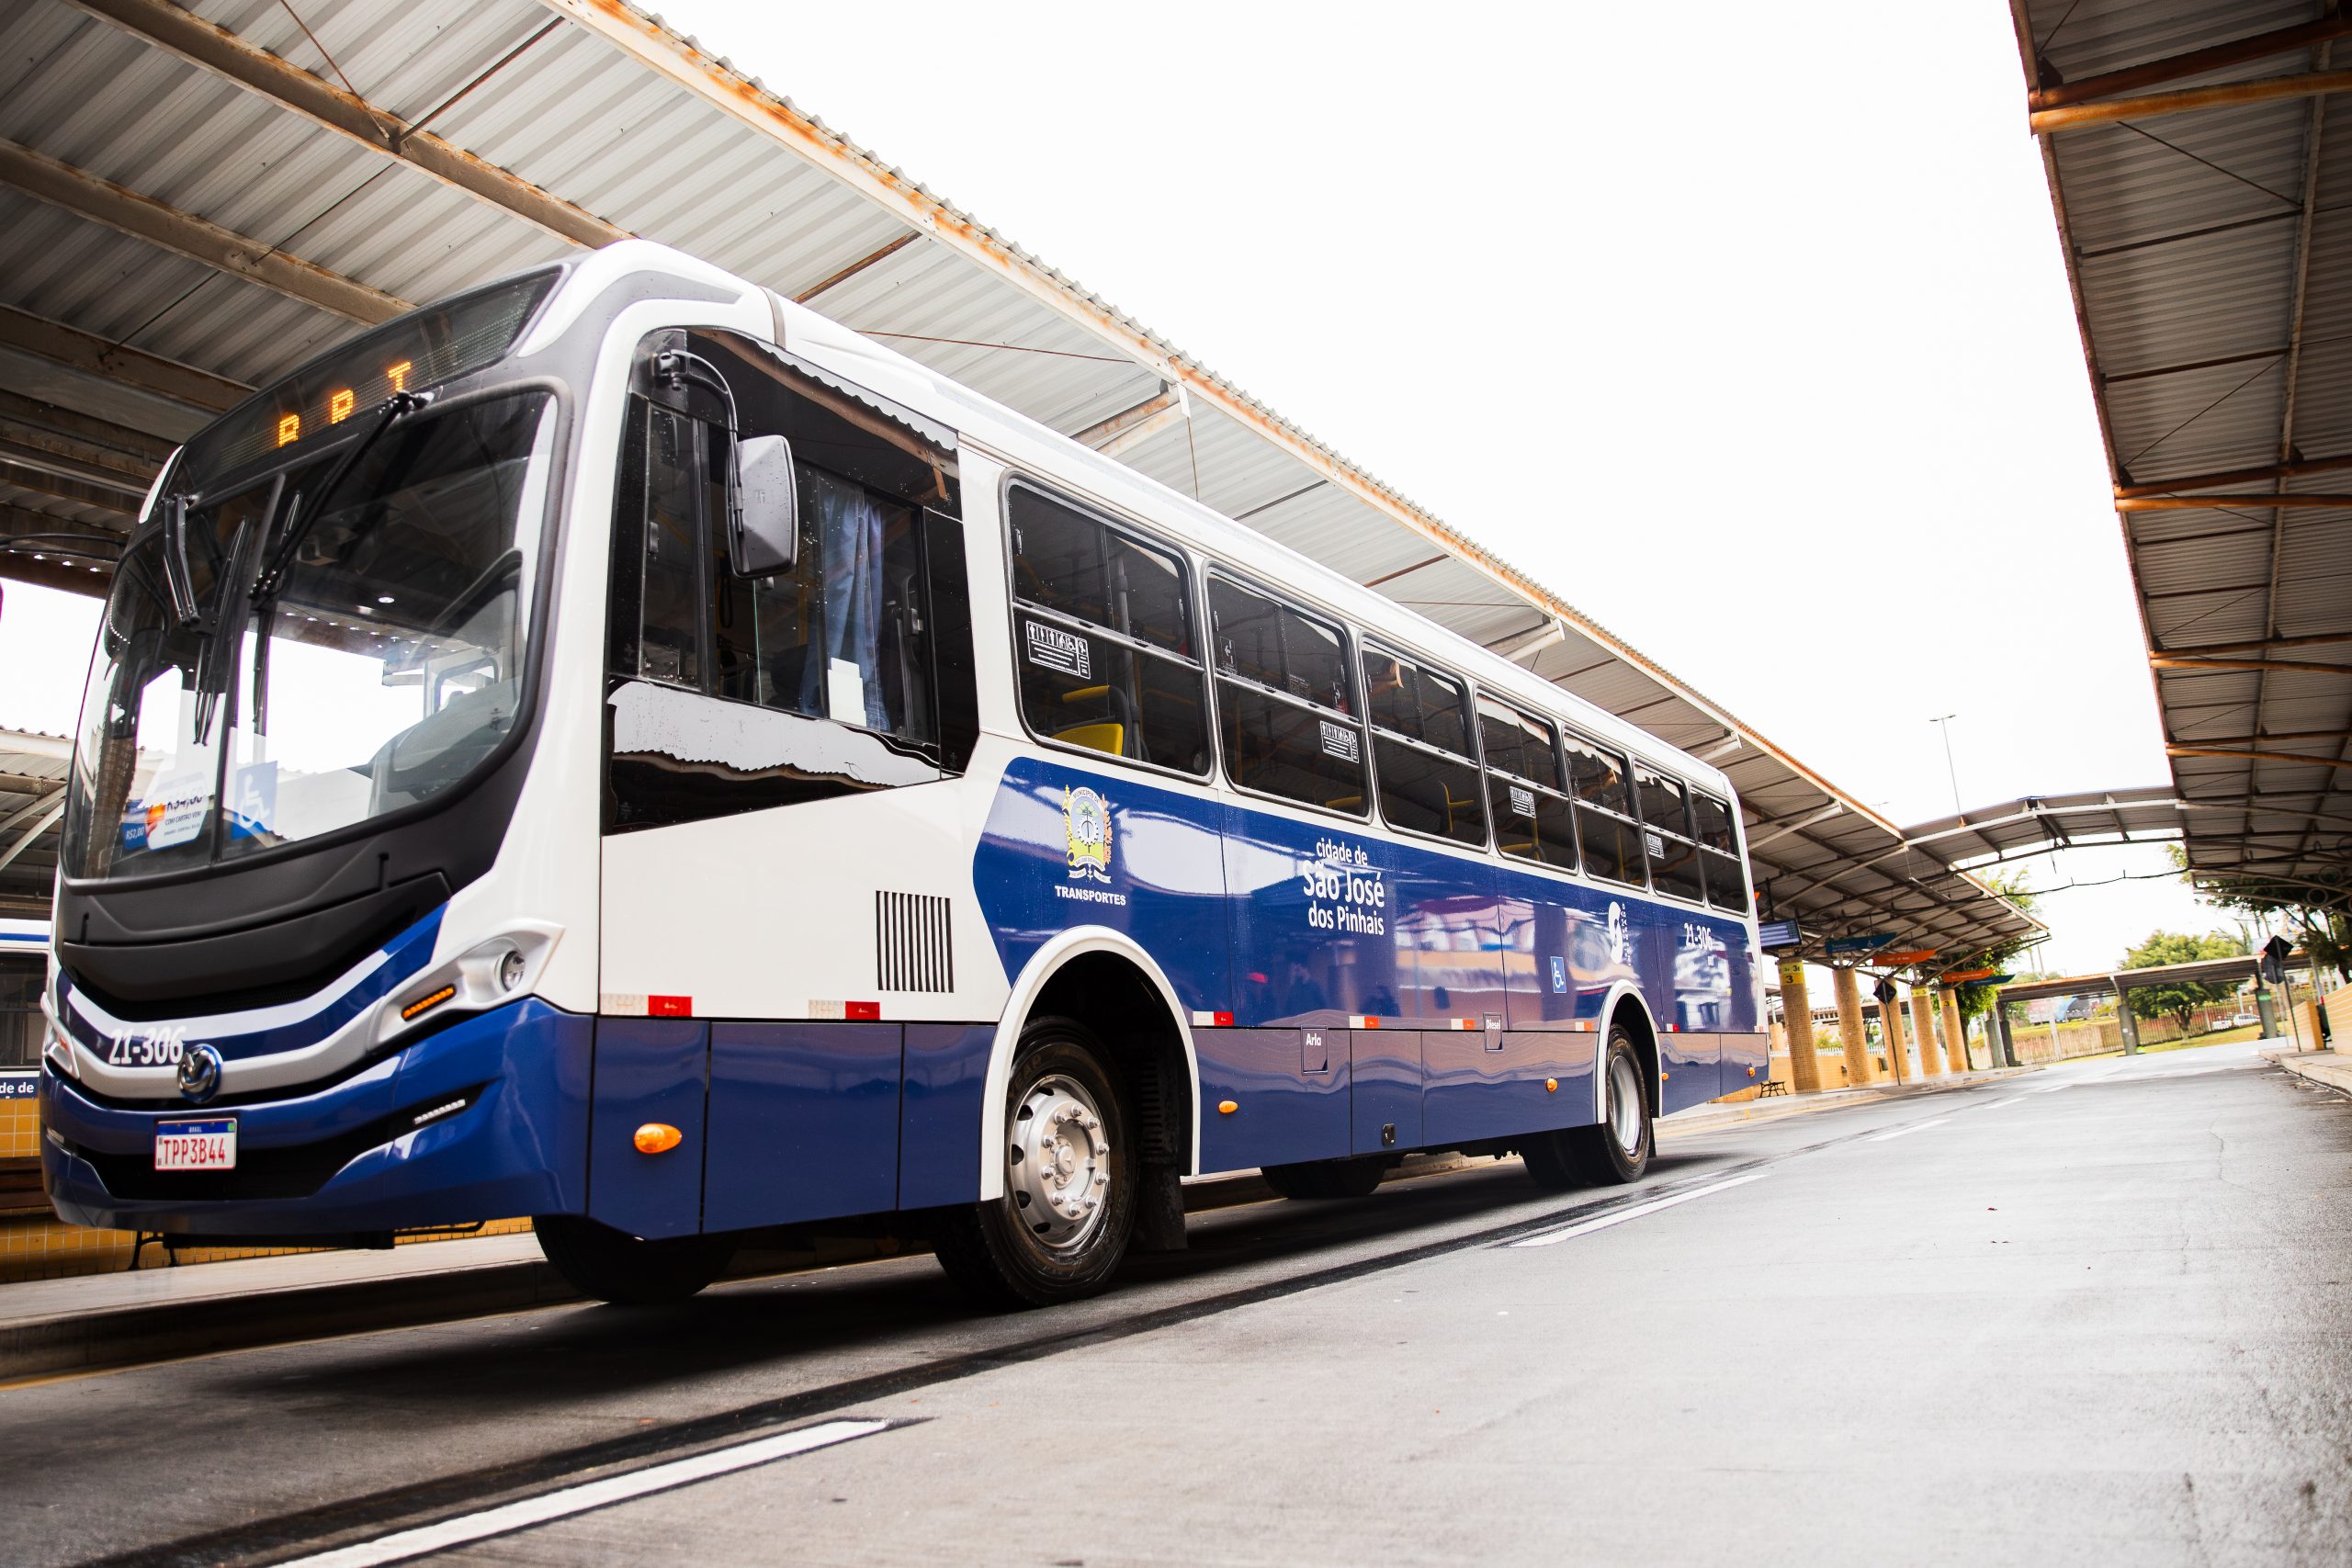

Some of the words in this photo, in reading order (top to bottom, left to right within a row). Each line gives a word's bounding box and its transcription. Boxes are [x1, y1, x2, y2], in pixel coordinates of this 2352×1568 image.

[1316, 837, 1352, 863] cidade
[1354, 845, 1368, 866] de
[1054, 885, 1126, 907] TRANSPORTES
[1303, 860, 1340, 901] São
[1345, 868, 1385, 908] José
[1308, 900, 1335, 930] dos
[1337, 905, 1385, 936] Pinhais
[1683, 922, 1713, 952] 21-306
[1785, 975, 1794, 984] 3
[1306, 1032, 1322, 1046] Arla
[1486, 1019, 1501, 1030] Diesel
[108, 1026, 187, 1065] 21-306
[17, 1081, 35, 1093] de
[164, 1137, 226, 1166] TPP3B44
